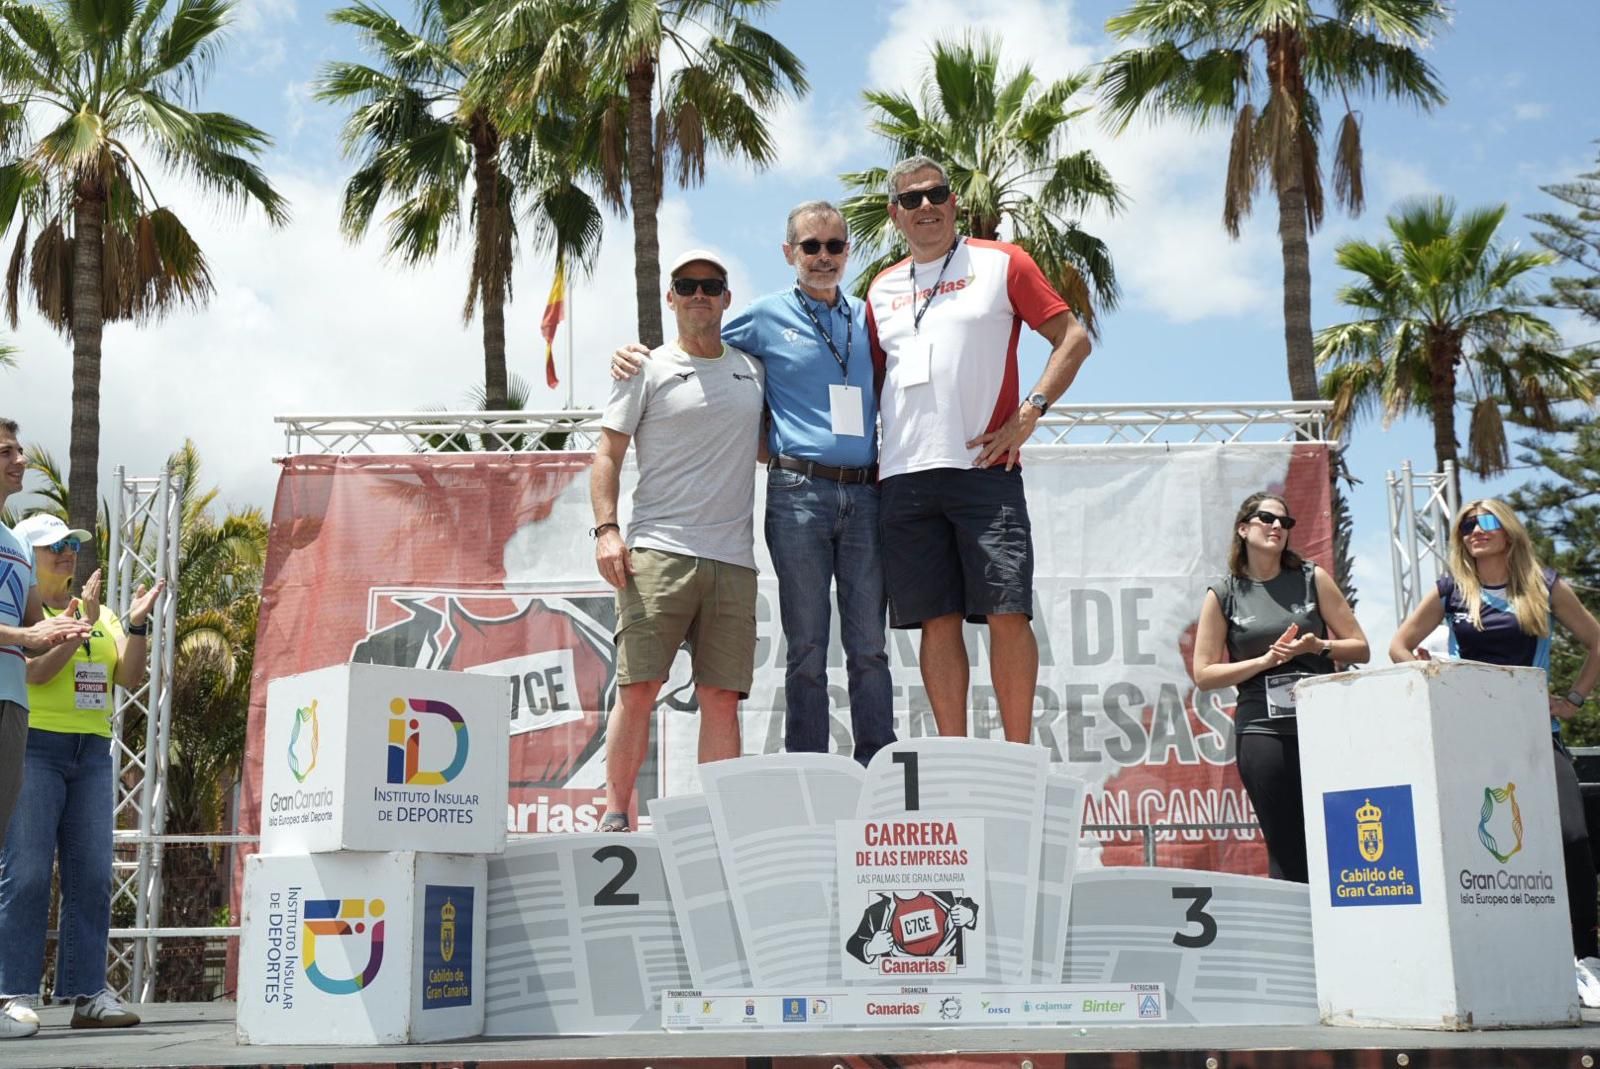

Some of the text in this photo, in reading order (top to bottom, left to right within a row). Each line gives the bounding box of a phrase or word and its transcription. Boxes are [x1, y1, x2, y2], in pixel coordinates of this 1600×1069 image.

[1070, 587, 1156, 666] DE
[79, 683, 104, 692] SPONSOR
[510, 666, 569, 721] 7CE
[892, 752, 919, 810] 1
[374, 787, 479, 805] INSTITUTO INSULAR
[279, 815, 300, 827] Europea
[301, 813, 309, 823] del
[311, 812, 333, 823] Deporte
[397, 807, 473, 824] DEPORTES
[864, 822, 958, 846] CARRERA
[856, 849, 968, 866] DE LAS EMPRESAS
[591, 845, 639, 906] 2
[857, 872, 965, 884] LAS PALMAS DE GRAN CANARIA
[1340, 866, 1404, 883] Cabildo de
[1336, 881, 1414, 897] Gran Canaria
[1460, 893, 1556, 907] Isla Europea del Deporte
[904, 916, 931, 935] C7CE
[1171, 887, 1218, 948] 3
[283, 887, 301, 1010] INSTITUTO INSULAR
[265, 914, 283, 1003] DEPORTES
[429, 968, 464, 983] Cabildo de
[427, 983, 468, 999] Gran Canaria
[1035, 1002, 1072, 1012] cajamar
[1082, 1000, 1125, 1013] Binter
